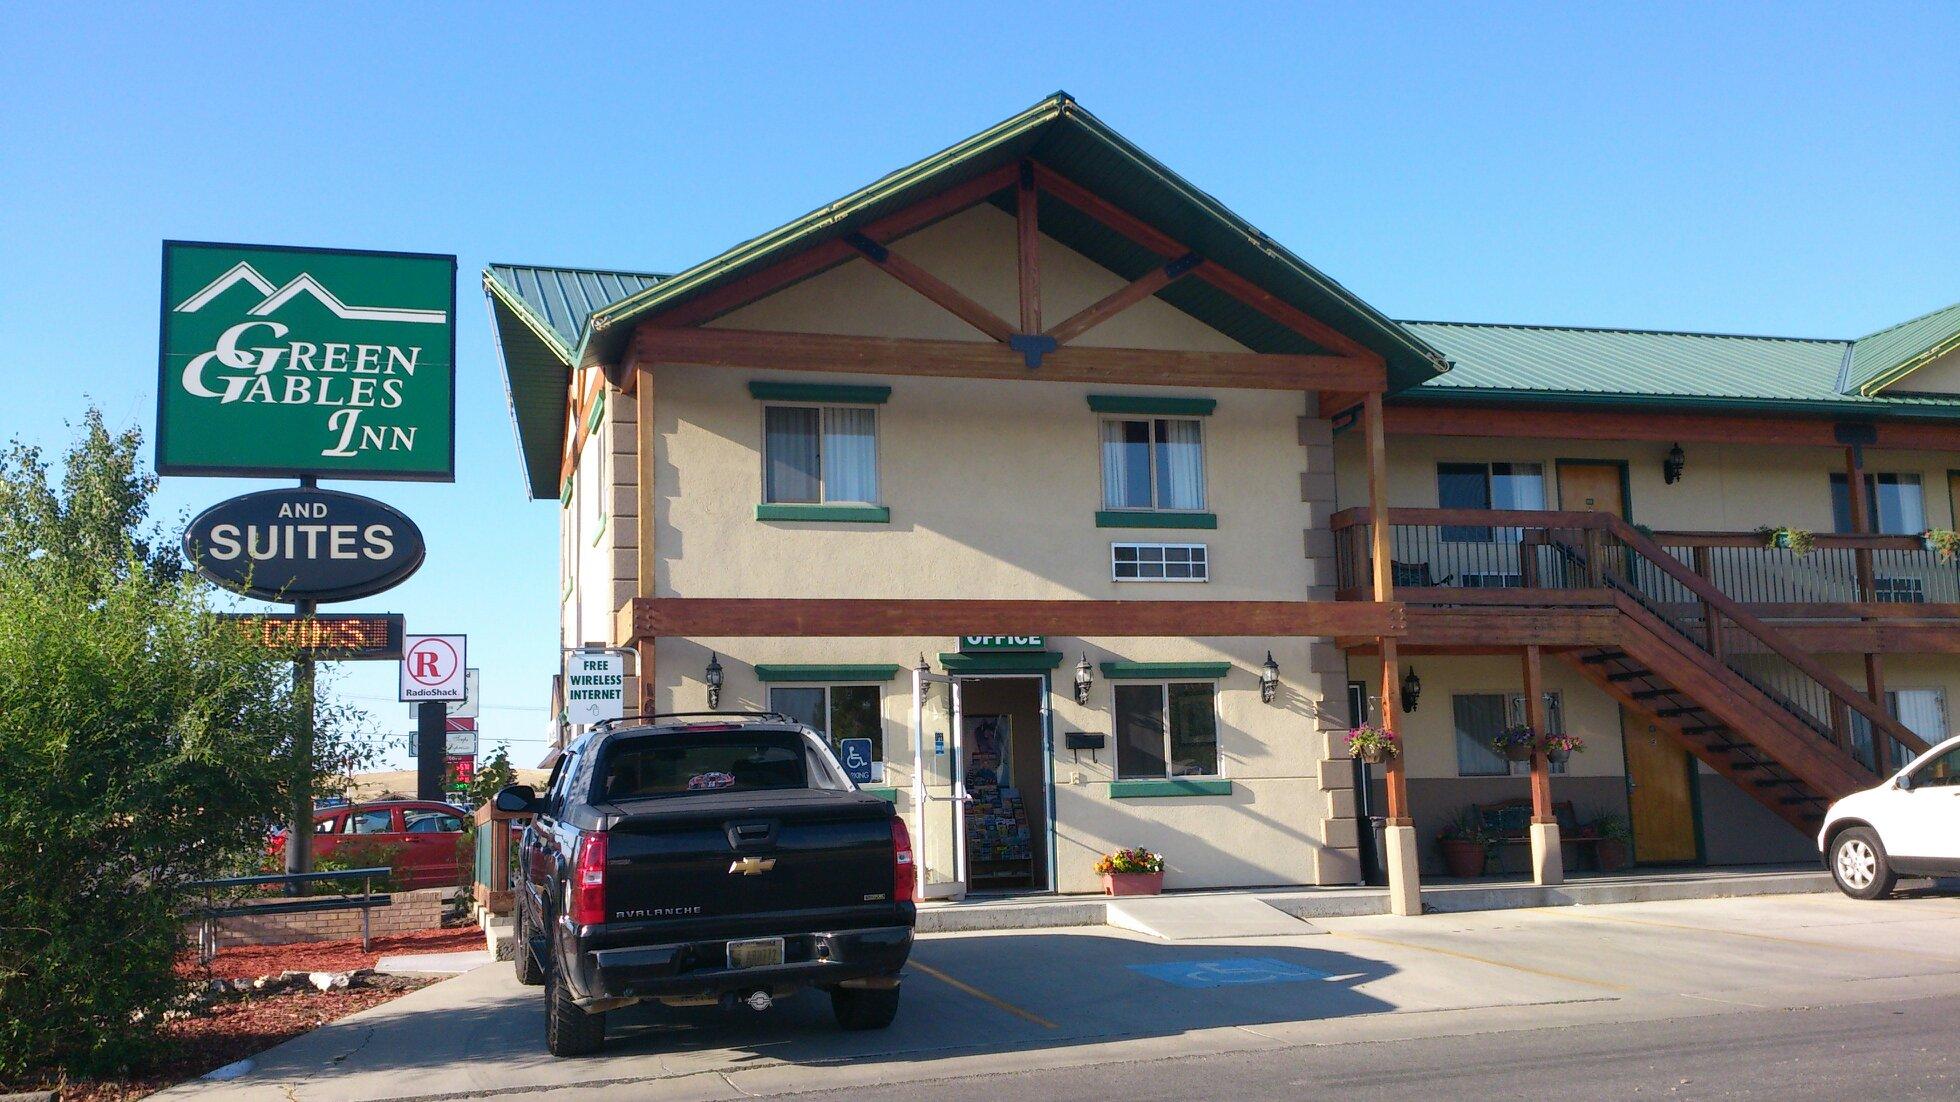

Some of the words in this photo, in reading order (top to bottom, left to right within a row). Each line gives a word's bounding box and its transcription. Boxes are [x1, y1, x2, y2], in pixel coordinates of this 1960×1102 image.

[216, 321, 422, 376] GREEN
[182, 349, 404, 409] GABLES
[321, 408, 418, 457] INN
[278, 502, 328, 519] AND
[209, 523, 394, 561] SUITES
[583, 660, 609, 671] FREE
[570, 674, 622, 686] WIRELESS
[406, 688, 458, 697] RadioShack
[569, 689, 622, 700] INTERNET
[616, 906, 701, 919] AVALANCHE
